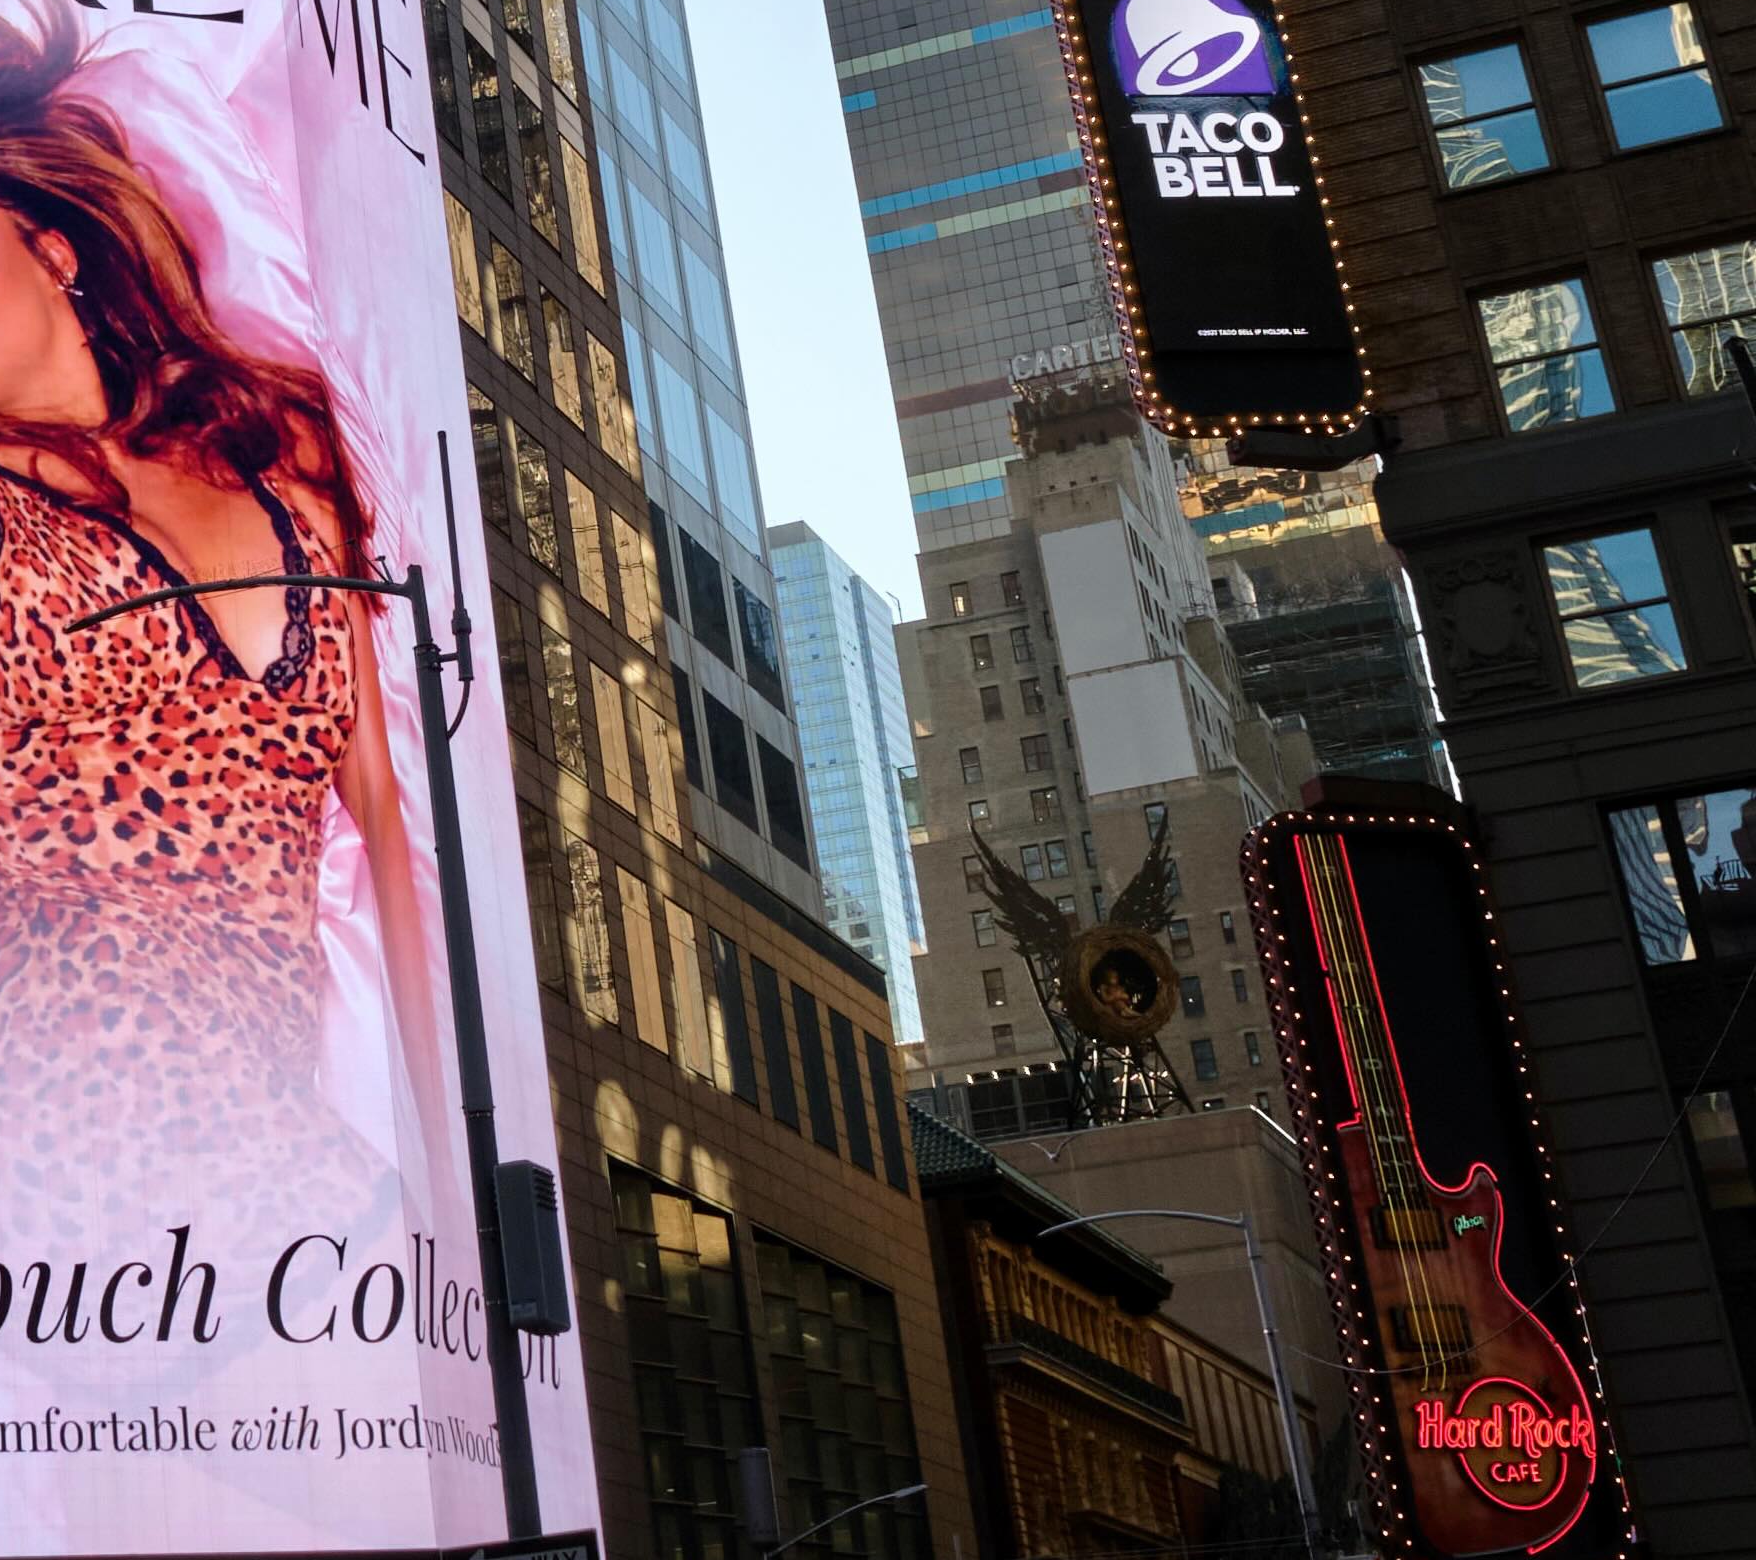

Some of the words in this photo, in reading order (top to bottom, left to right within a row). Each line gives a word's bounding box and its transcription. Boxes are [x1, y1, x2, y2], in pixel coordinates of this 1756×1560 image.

[1130, 110, 1286, 155] TACO
[1152, 156, 1299, 198] BELL
[230, 1404, 320, 1455] with
[333, 1404, 447, 1461] Jordyn
[1414, 1399, 1503, 1451] Hard
[1507, 1401, 1598, 1459] Rock
[1490, 1461, 1543, 1484] CAFE
